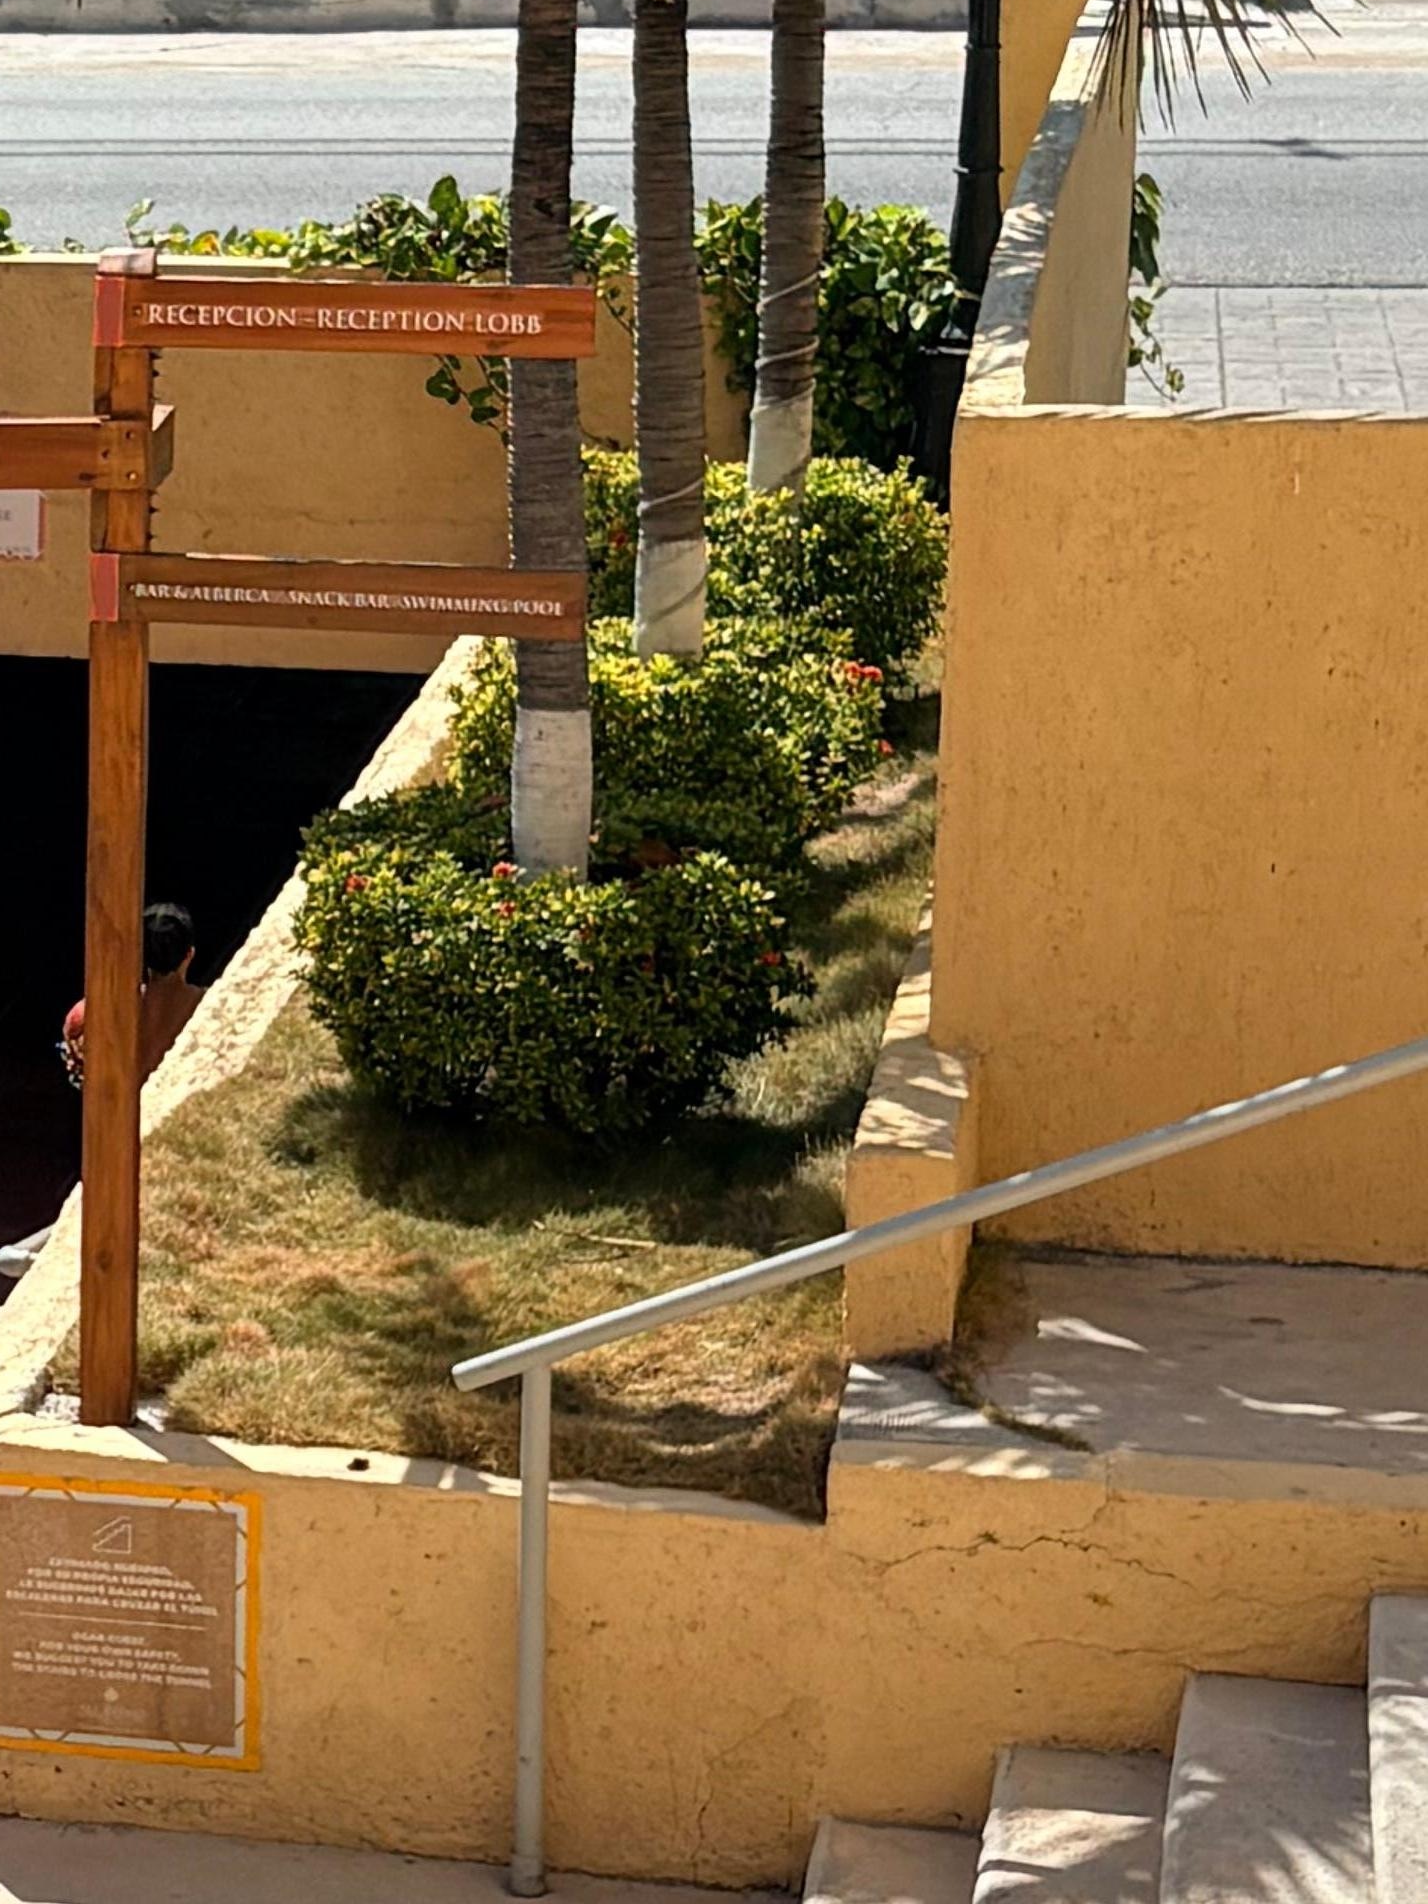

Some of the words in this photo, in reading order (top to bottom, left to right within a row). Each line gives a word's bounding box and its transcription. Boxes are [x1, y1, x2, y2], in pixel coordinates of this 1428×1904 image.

[148, 304, 296, 326] RECEPCION
[317, 308, 465, 332] RECEPTION
[475, 312, 542, 334] LOBB
[134, 583, 170, 598] BAR
[191, 586, 269, 602] ALBERCA
[289, 590, 350, 607] SNACK
[354, 593, 390, 608] BAR
[513, 599, 564, 616] POOL
